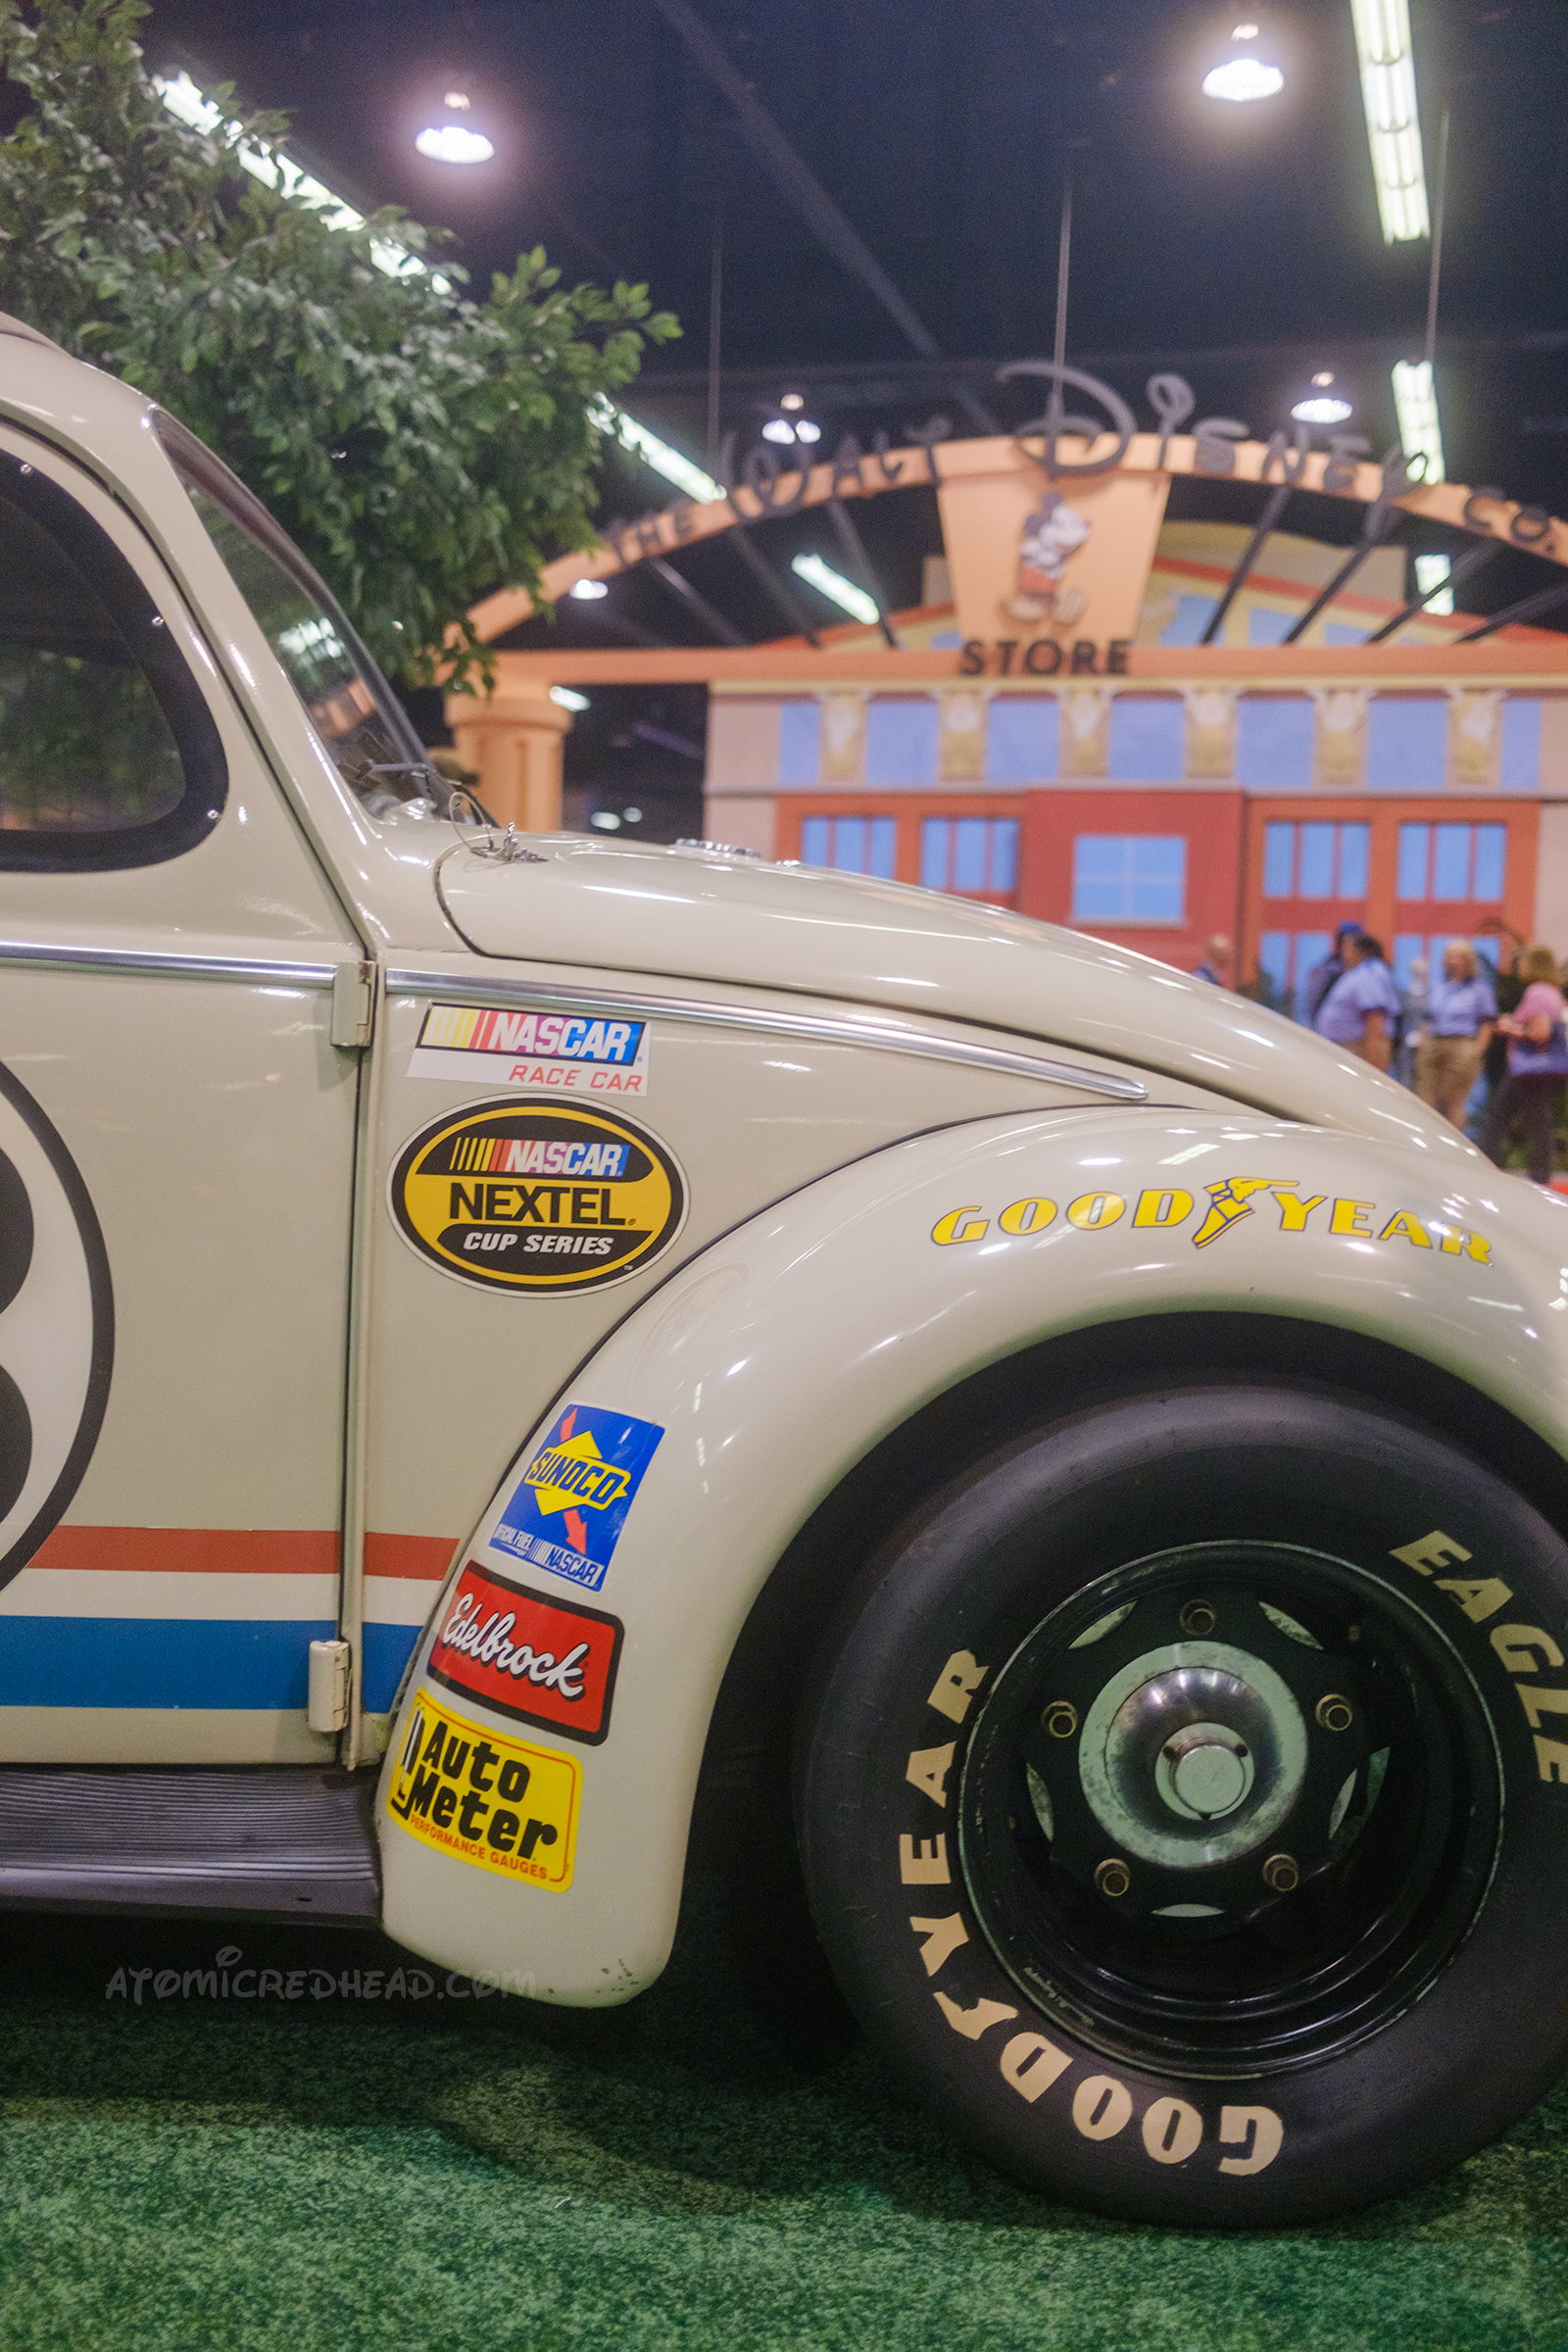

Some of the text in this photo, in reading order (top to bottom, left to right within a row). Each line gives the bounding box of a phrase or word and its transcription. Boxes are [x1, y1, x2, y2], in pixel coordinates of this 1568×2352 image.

[960, 638, 1130, 676] STORE
[489, 1013, 632, 1061] NASCAR
[509, 1064, 643, 1093] RACE CAR
[505, 1140, 623, 1177] NASCAR
[449, 1182, 626, 1226] NEXTEL
[464, 1232, 614, 1255] CUP SERIES
[528, 1451, 624, 1504] SUNOCO
[545, 1546, 600, 1584] NASCAR
[443, 1592, 590, 1700] Edelbrock
[421, 1720, 530, 1803] Auto
[407, 1763, 558, 1860] Meter
[409, 1813, 548, 1881] PERFORMANCE GAUGES
